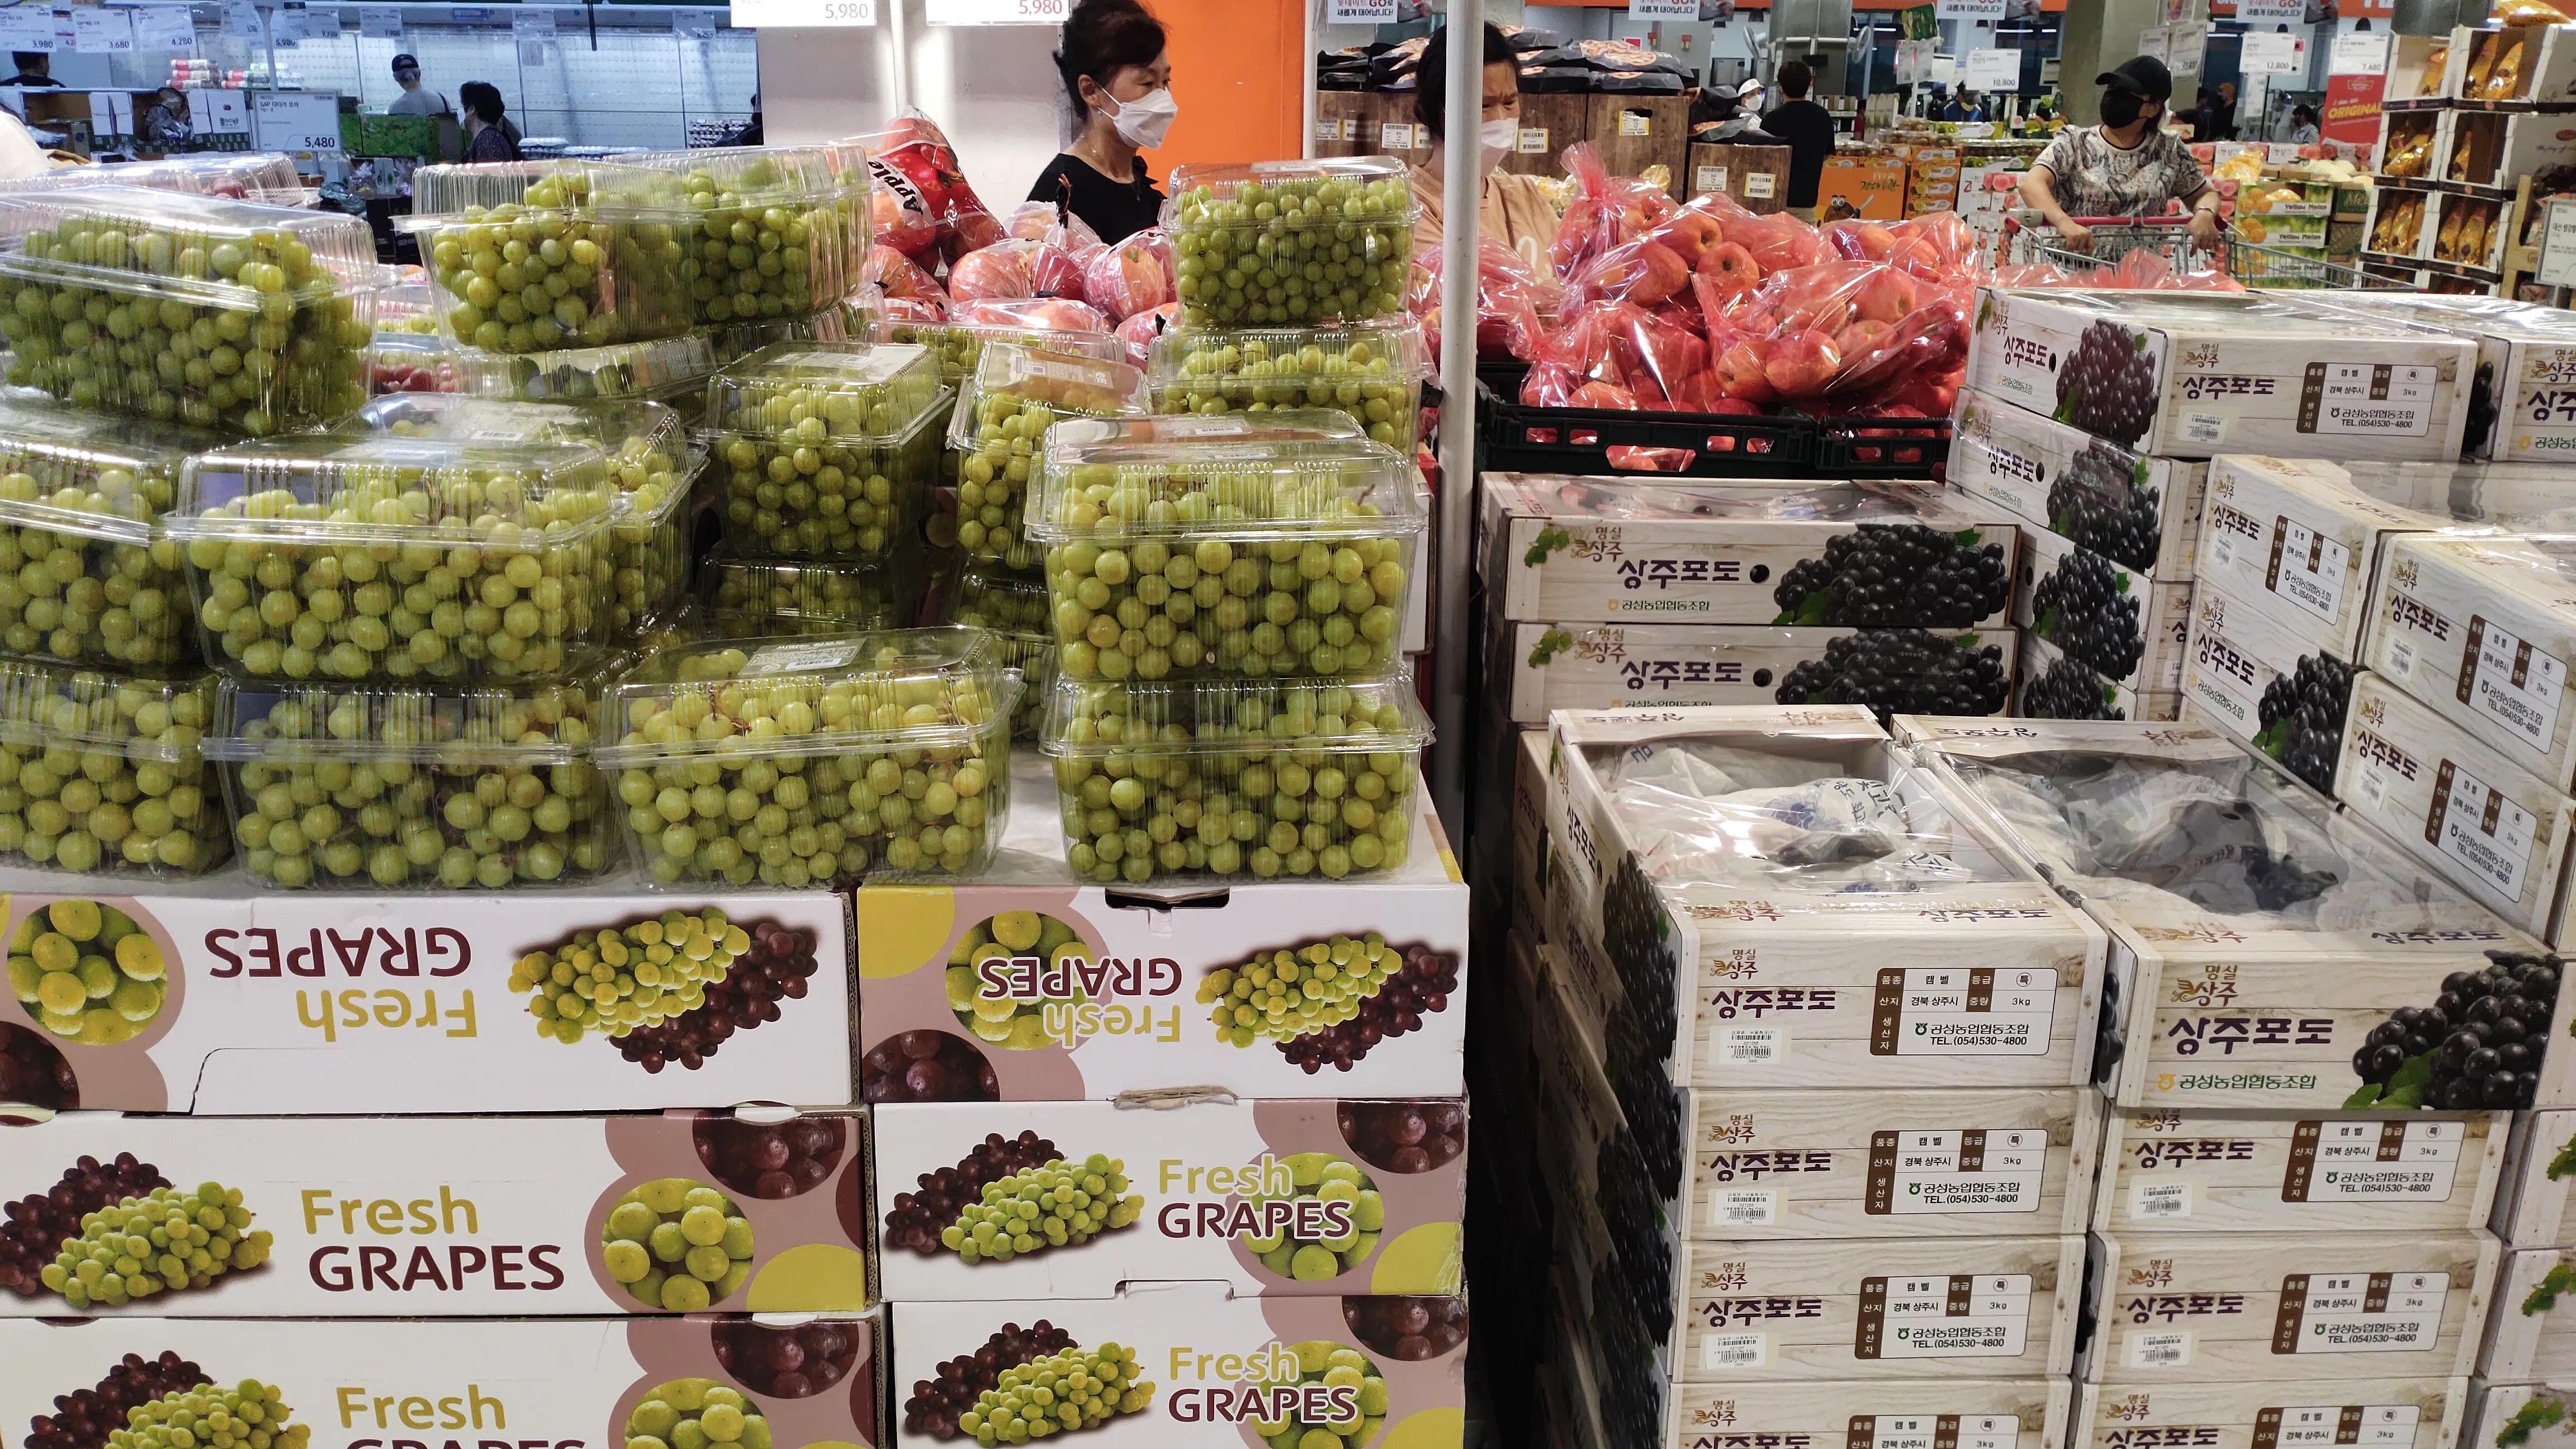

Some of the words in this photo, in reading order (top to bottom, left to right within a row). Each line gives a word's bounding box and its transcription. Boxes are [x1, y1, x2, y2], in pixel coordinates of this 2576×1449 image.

[825, 3, 869, 20] 5,980
[1018, 0, 1063, 16] 5,980
[305, 137, 335, 149] 5,480
[868, 161, 923, 215] Apple
[2004, 335, 2047, 368] 상주포도
[2182, 376, 2275, 399] 상주포도
[2329, 386, 2342, 394] 경북
[2345, 386, 2364, 395] 상주시
[2342, 419, 2412, 429] TEL.(054)530-4800
[1988, 445, 2034, 482] 상주포도
[2213, 505, 2261, 541] 상주포도
[1595, 526, 1622, 542] 명실
[1589, 541, 1625, 562] 상주
[1617, 560, 1740, 590] 상주포도
[1622, 599, 1710, 612] 공성농업협동조합
[2390, 593, 2450, 642] 상주포도
[1598, 628, 1625, 642] 명실
[1592, 642, 1627, 664] 상주
[2198, 631, 2256, 686] 상주포도
[1620, 660, 1742, 690] 상주포도
[2374, 697, 2385, 712] 명실
[2488, 698, 2540, 737] TEL.(054)530-4800
[2357, 730, 2418, 783] 상주포도
[2457, 841, 2511, 885] TEL.(054)530-4800
[1918, 908, 2053, 922] 상주포도
[2371, 930, 2506, 945] 상주포도
[203, 926, 472, 980] GRAPES
[1731, 948, 1756, 960] 명실
[980, 957, 1182, 998] GRAPES
[1728, 960, 1758, 980] 상주
[2204, 964, 2238, 981] 명실
[1881, 974, 1902, 985] 품종
[1971, 974, 1991, 985] 등급
[2019, 974, 2029, 985] 특
[1879, 996, 1898, 1006] 산지
[1911, 996, 1929, 1006] 경북
[1931, 996, 1958, 1006] 상주시
[1969, 996, 1988, 1006] 중량
[2011, 996, 2031, 1006] 3kg
[2195, 981, 2239, 1007] 상주
[1712, 989, 1835, 1019] 상주포도
[296, 988, 477, 1043] Fresh
[1046, 1003, 1180, 1048] Fresh
[1930, 1022, 2029, 1035] 공성농업협동조합
[1930, 1035, 2028, 1046] TEL.(054)530-4800
[2167, 1017, 2334, 1055] 상주포도
[2179, 1074, 2317, 1090] 공성농업협동조합
[1730, 1114, 1754, 1126] 명실
[2153, 1116, 2182, 1132] 상주
[1725, 1126, 1755, 1145] 상주
[1876, 1137, 1896, 1147] 품종
[1963, 1136, 1983, 1146] 등급
[2010, 1135, 2020, 1145] 특
[2133, 1141, 2255, 1169] 상주포도
[2324, 1147, 2342, 1157] 경북
[2345, 1147, 2370, 1157] 상주시
[2419, 1147, 2438, 1157] 3kg
[1710, 1152, 1831, 1182] 상주포도
[1873, 1157, 1893, 1167] 산지
[1904, 1157, 1922, 1167] 경북
[1924, 1156, 1951, 1167] 상주시
[2004, 1156, 2023, 1166] 3kg
[1159, 1156, 1290, 1195] Fresh
[2341, 1171, 2433, 1183] 공성농업협동조합
[1924, 1181, 2020, 1194] 공성농업협동조합
[2339, 1183, 2431, 1194] TEL.(054)530-4800
[1923, 1194, 2018, 1205] TEL.(054)530-4800
[301, 1185, 480, 1237] Fresh
[1158, 1201, 1352, 1238] GRAPES
[308, 1243, 564, 1294] GRAPES
[1722, 1261, 1746, 1273] 명실
[2149, 1258, 2173, 1270] 명실
[1717, 1272, 1749, 1291] 상주
[2143, 1270, 2174, 1289] 상주
[1863, 1303, 1883, 1313] 산지
[1893, 1302, 1911, 1313] 경북
[1912, 1301, 1939, 1311] 상주시
[1990, 1300, 2007, 1311] 3kg
[2127, 1295, 2244, 1324] 상주포도
[2313, 1299, 2330, 1309] 경북
[2332, 1298, 2357, 1309] 상주시
[2405, 1298, 2423, 1308] 3kg
[1702, 1298, 1822, 1328] 상주포도
[1912, 1326, 2006, 1338] 공성농업협동조합
[2328, 1322, 2419, 1334] 공성농업협동조합
[1911, 1338, 2005, 1349] TEL.(054)530-4800
[2327, 1333, 2417, 1344] TEL.(054)530-4800
[1168, 1343, 1299, 1381] Fresh
[335, 1384, 507, 1430] Fresh
[1168, 1386, 1357, 1424] GRAPES
[1712, 1400, 1735, 1411] 명실
[1707, 1409, 1737, 1427] 상주
[1881, 1439, 1898, 1448] 경북
[1900, 1439, 1926, 1448] 상주시
[1976, 1439, 1995, 1448] 3kg
